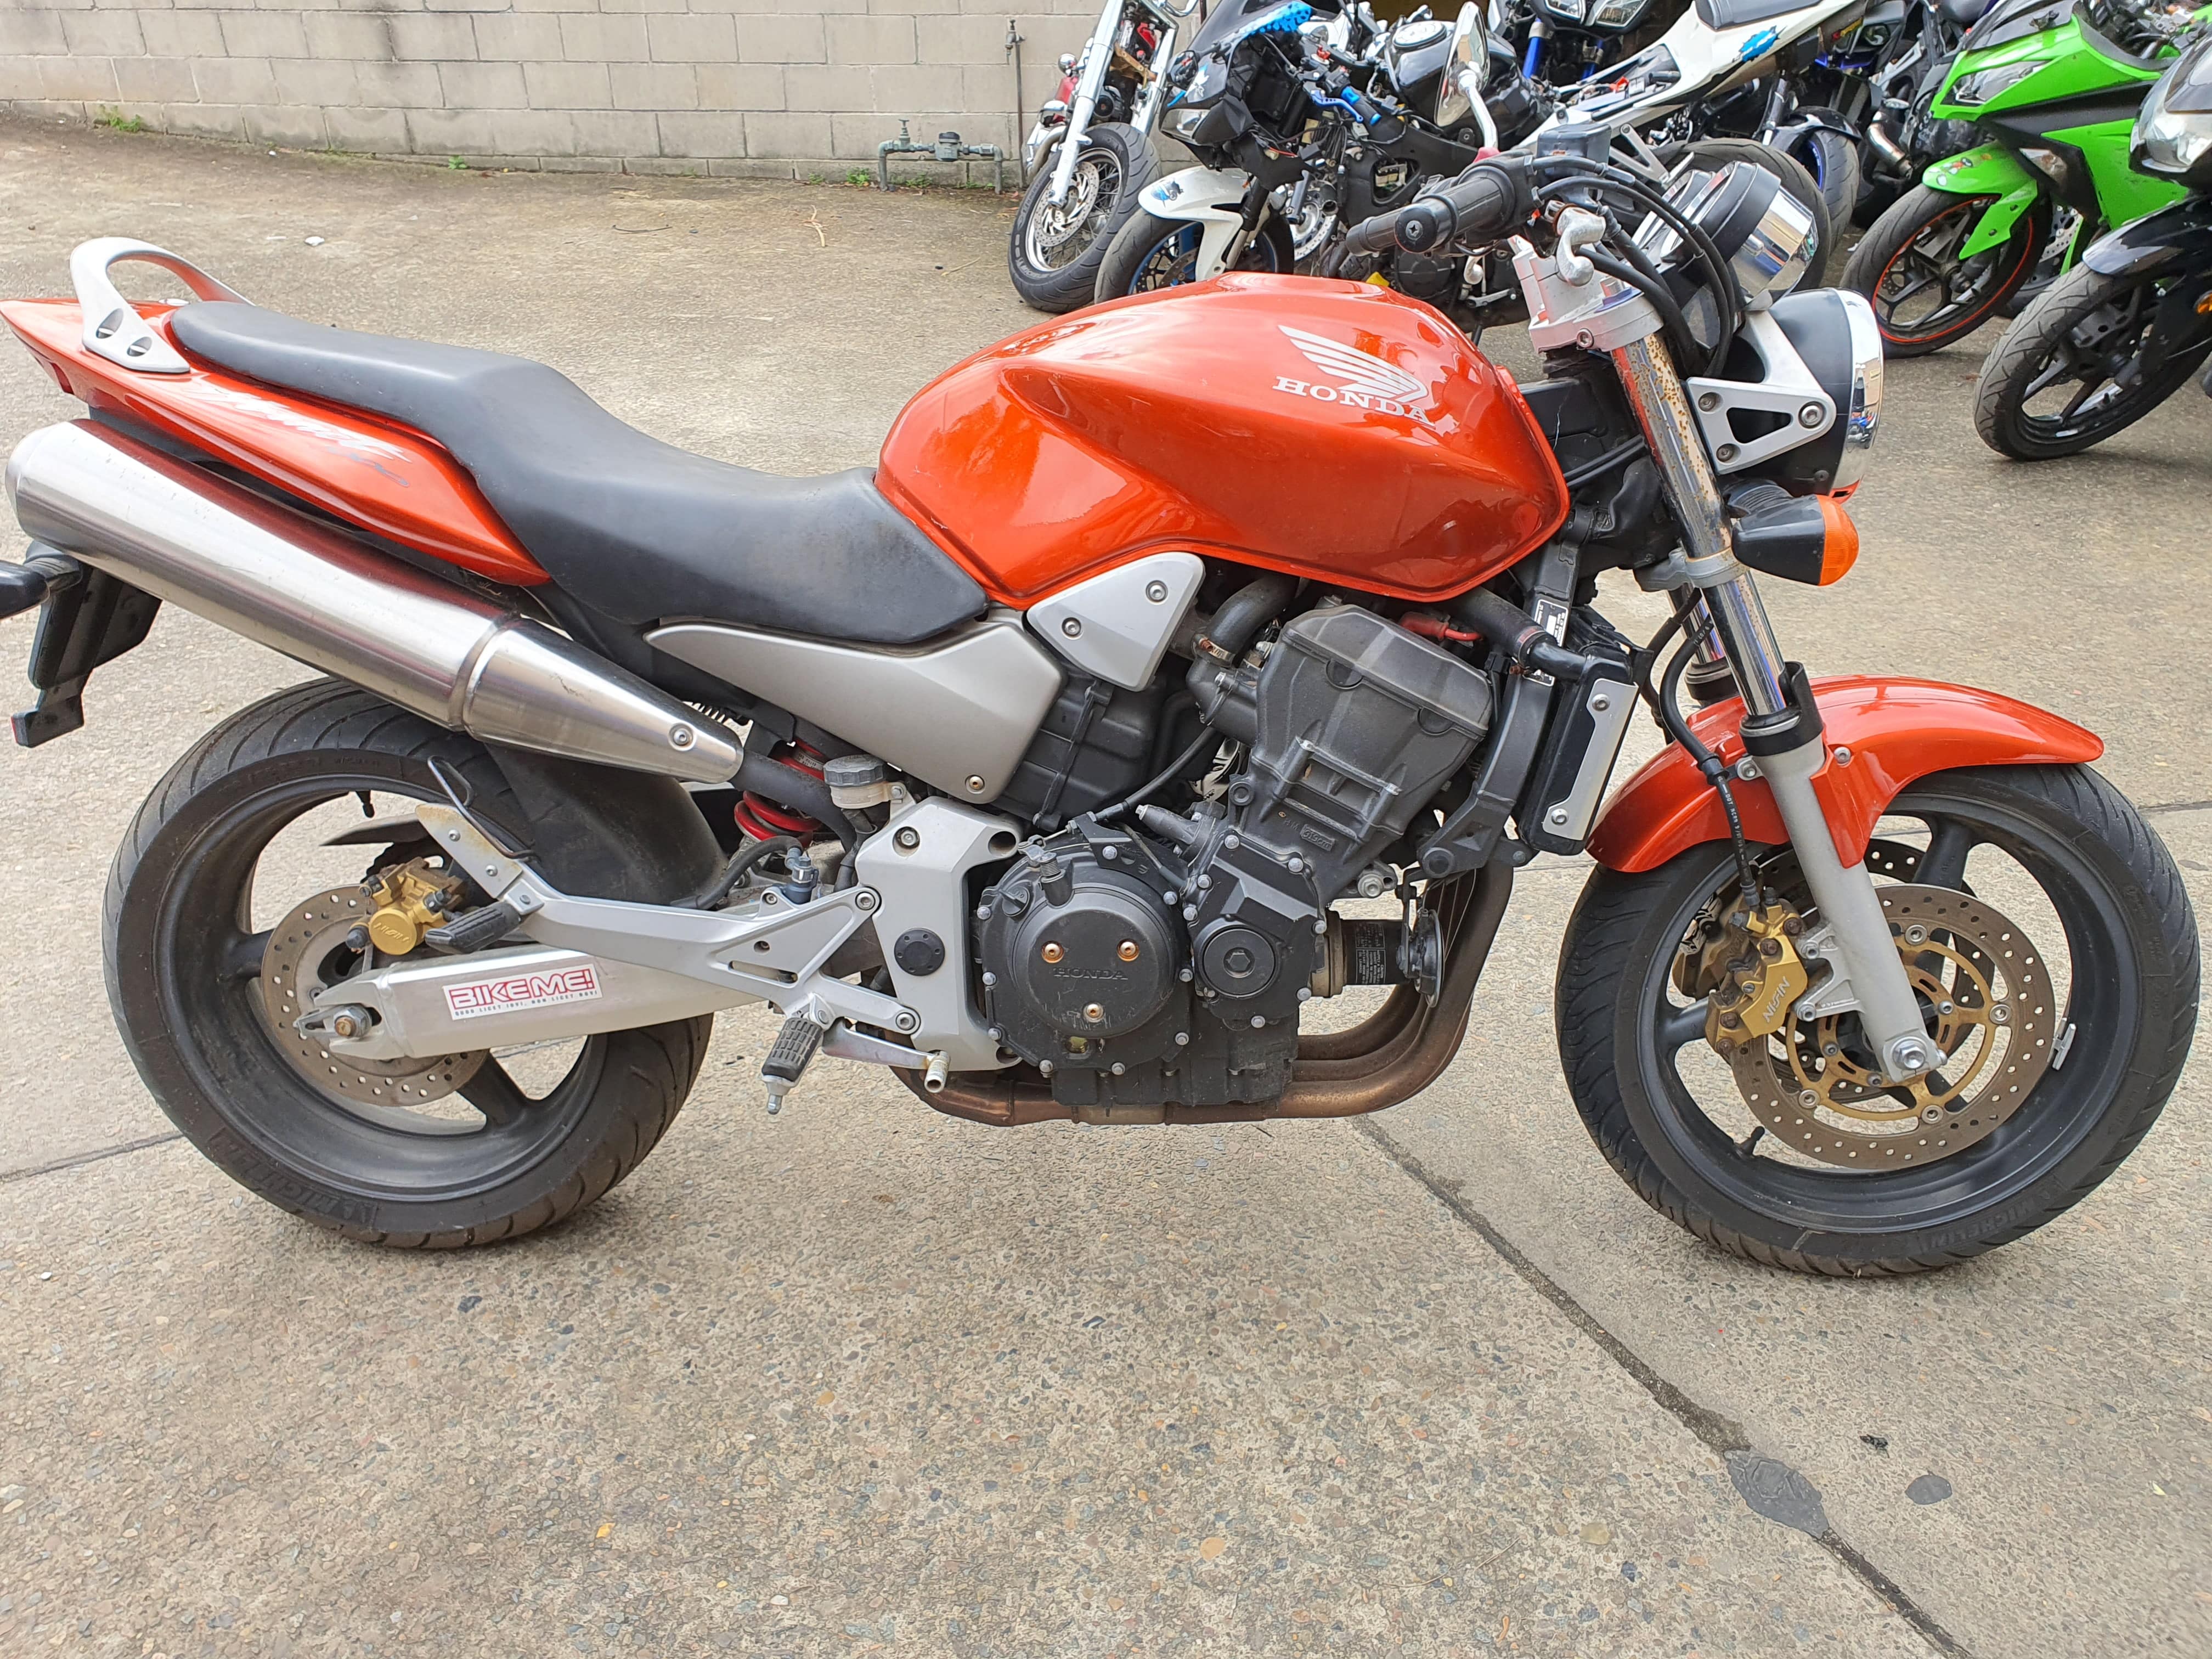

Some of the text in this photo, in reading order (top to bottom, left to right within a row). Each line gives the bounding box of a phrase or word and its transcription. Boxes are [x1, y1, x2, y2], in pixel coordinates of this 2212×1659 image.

[1272, 375, 1436, 427] HONDA
[1053, 967, 1128, 980] HONDA
[1763, 975, 1790, 1023] NISSIN
